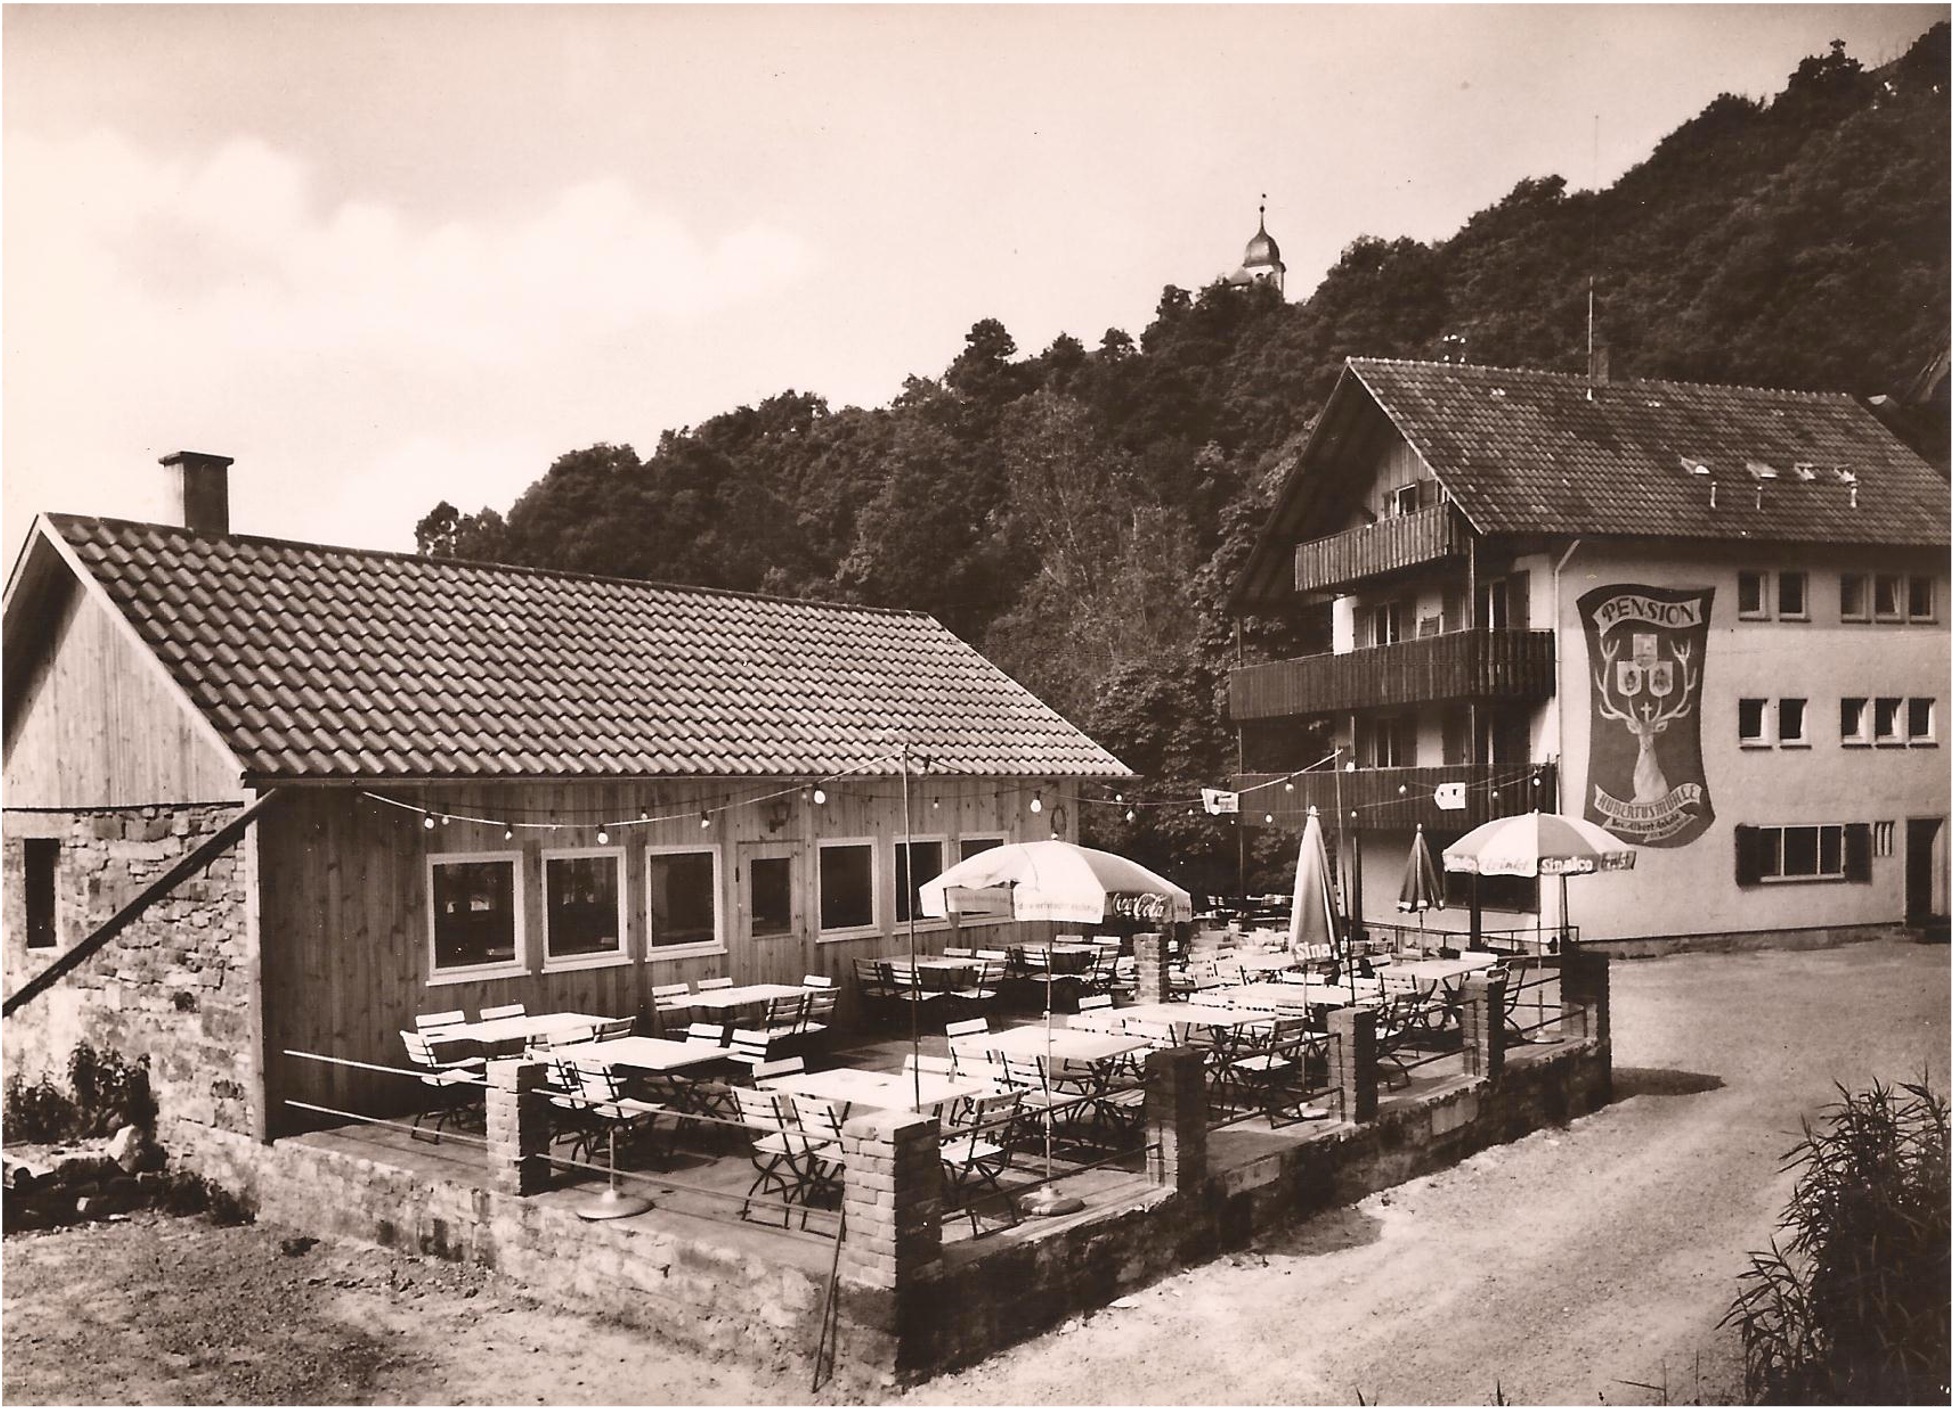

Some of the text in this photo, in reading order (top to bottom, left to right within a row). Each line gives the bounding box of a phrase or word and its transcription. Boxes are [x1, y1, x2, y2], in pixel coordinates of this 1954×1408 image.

[1601, 597, 1695, 624] PENSION
[1541, 856, 1594, 874] Sinalco
[1112, 892, 1168, 919] Coca-Cola
